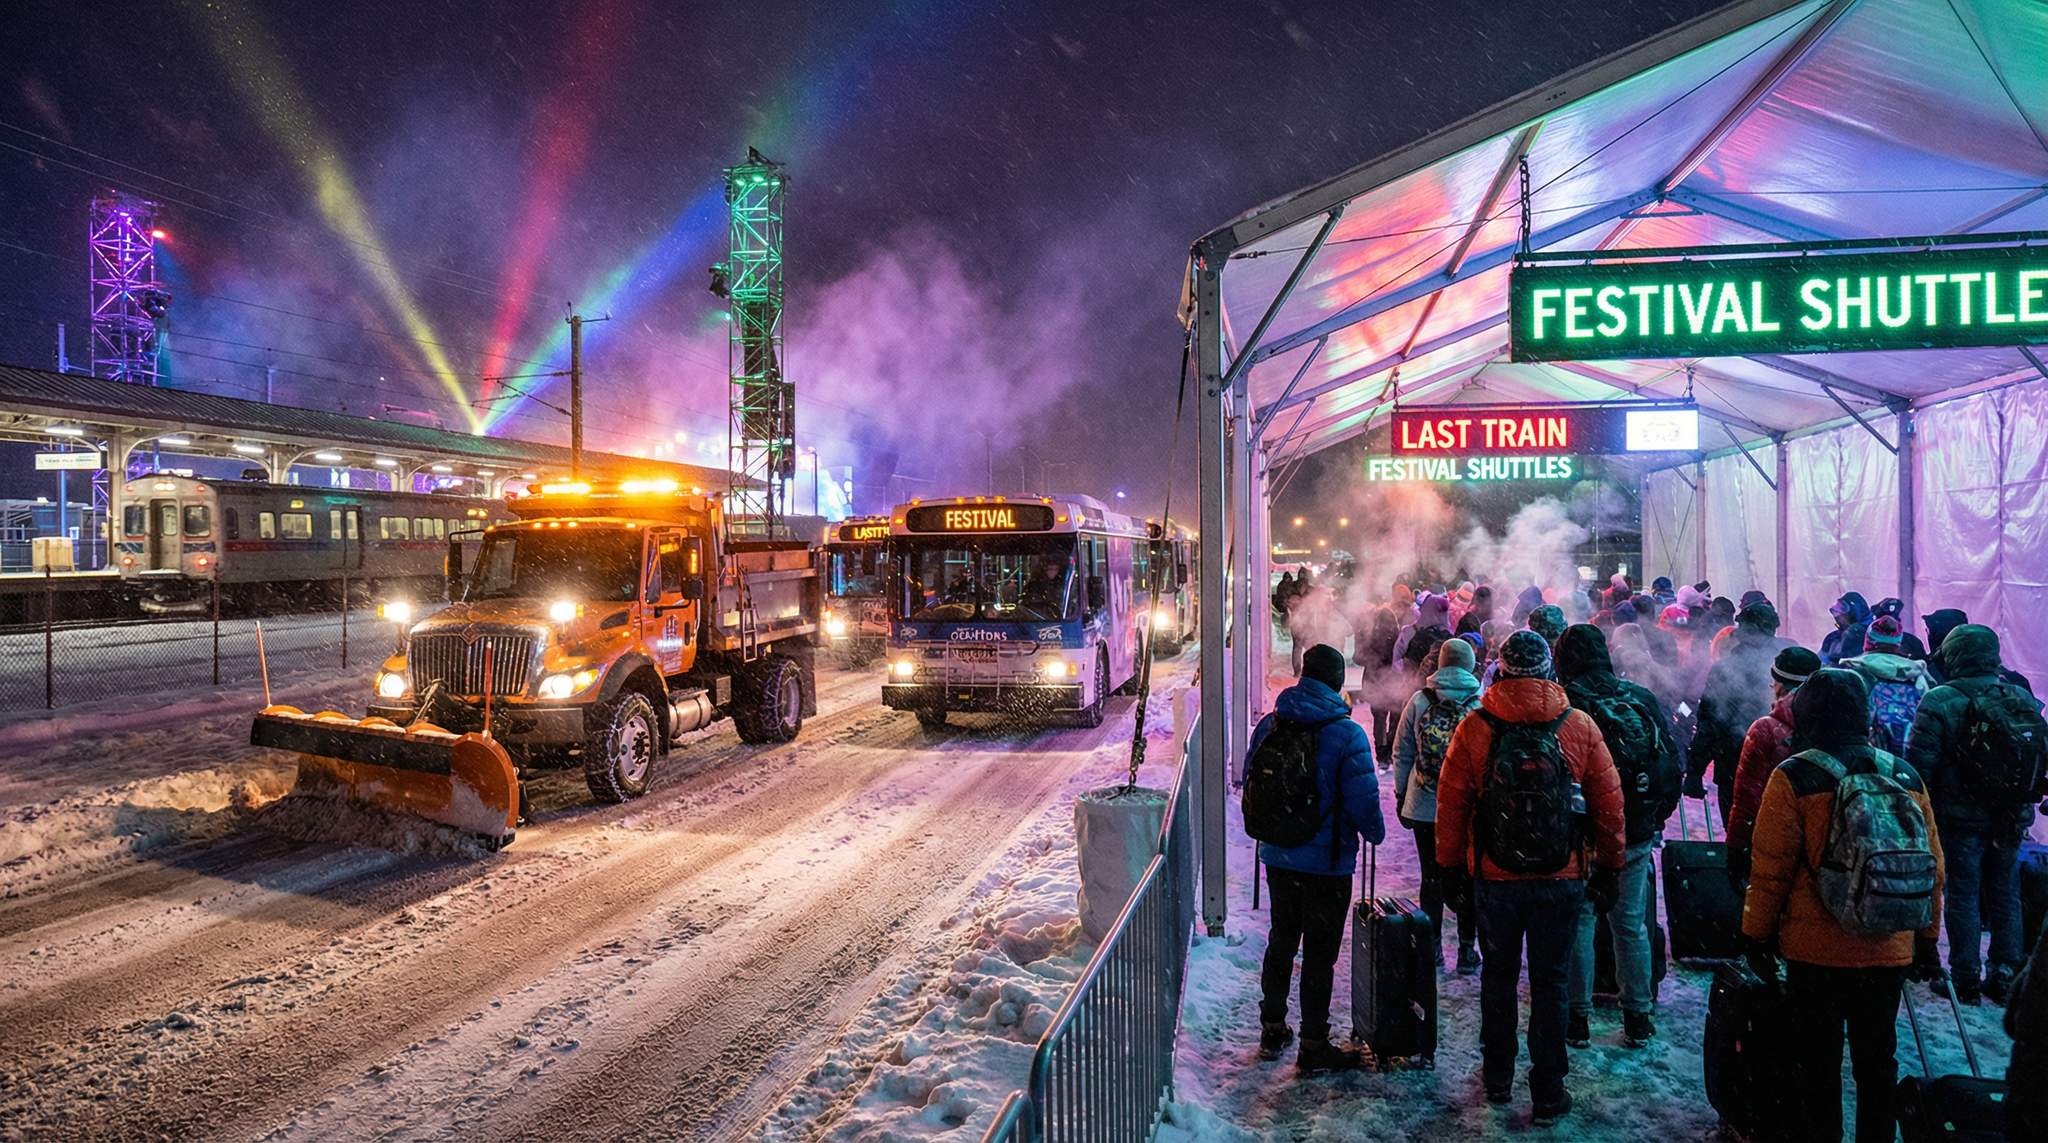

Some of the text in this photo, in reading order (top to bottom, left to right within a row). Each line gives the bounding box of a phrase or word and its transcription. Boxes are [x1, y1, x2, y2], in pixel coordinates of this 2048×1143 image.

[1532, 270, 2048, 339] FESTIVAL SHUTTLE
[1402, 418, 1568, 449] LAST TRAIN
[1369, 456, 1572, 481] FESTIVAL SHUTTLES
[945, 509, 1016, 529] FESTIVAL
